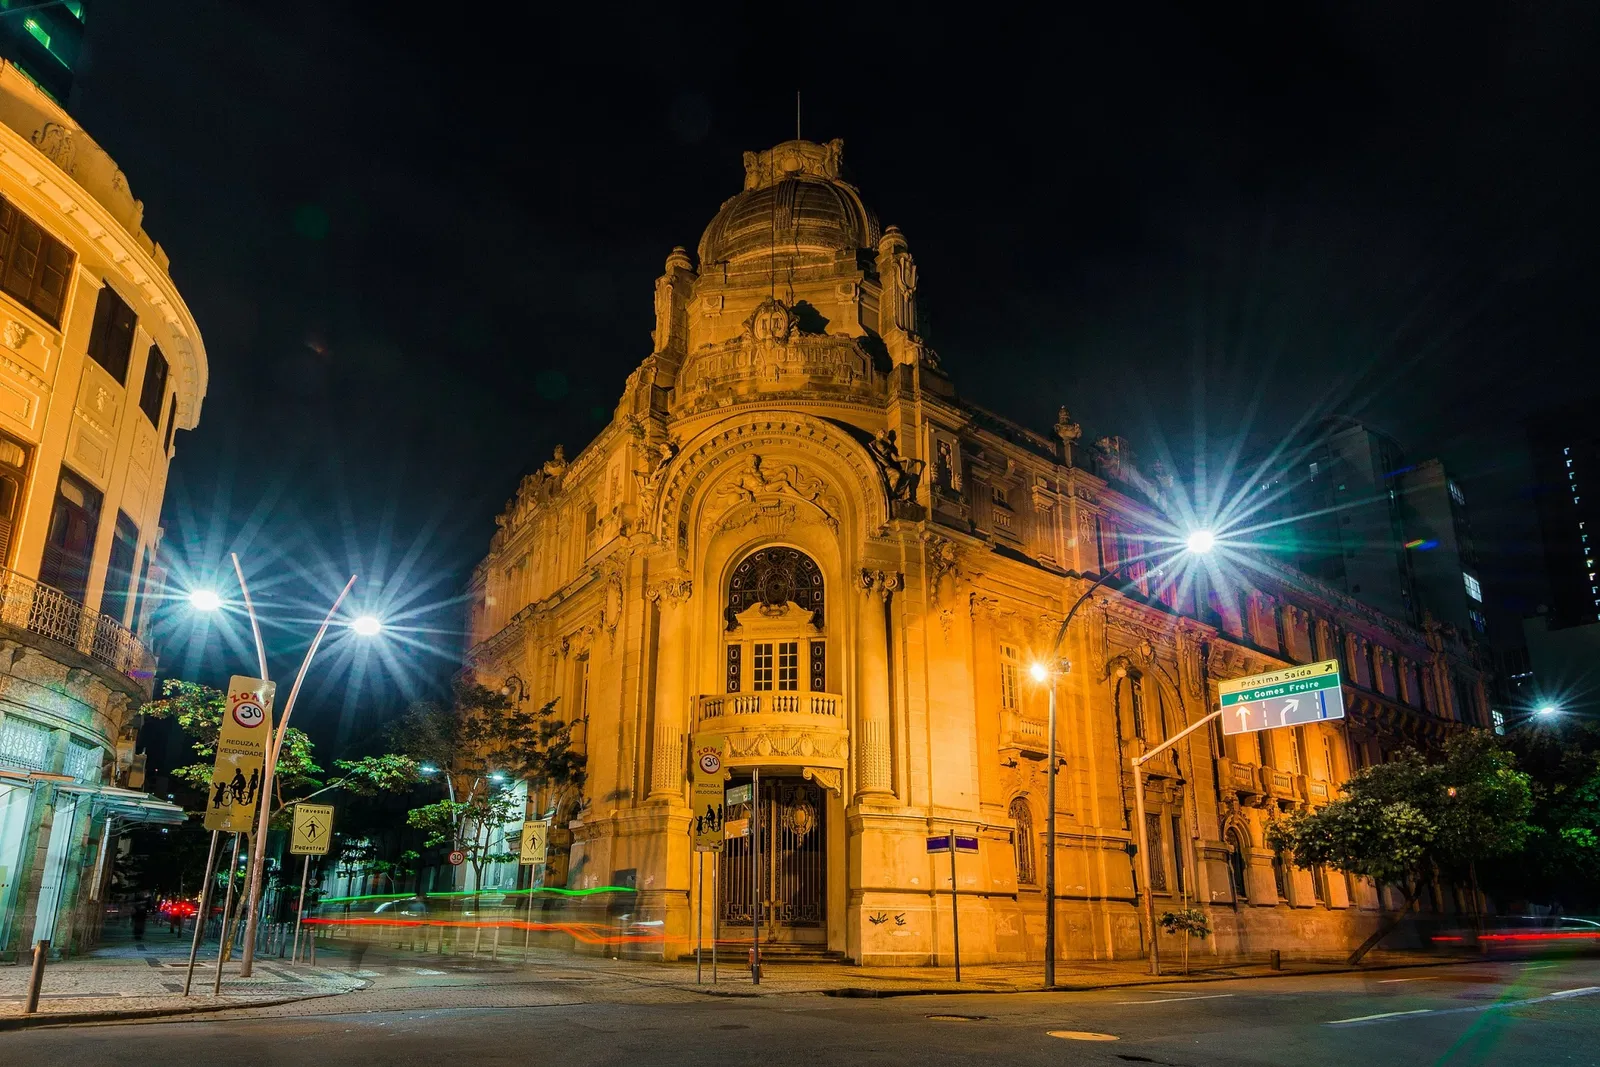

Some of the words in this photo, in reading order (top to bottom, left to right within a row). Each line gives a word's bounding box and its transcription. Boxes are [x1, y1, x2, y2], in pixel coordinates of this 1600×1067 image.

[1241, 676, 1280, 688] Próxima
[1284, 668, 1312, 678] Saída
[1254, 688, 1284, 698] Gomes
[1290, 681, 1319, 692] Freire
[240, 706, 261, 718] 30
[220, 748, 262, 757] VELOCIDADE
[696, 746, 722, 756] ZONA
[704, 757, 718, 767] 30
